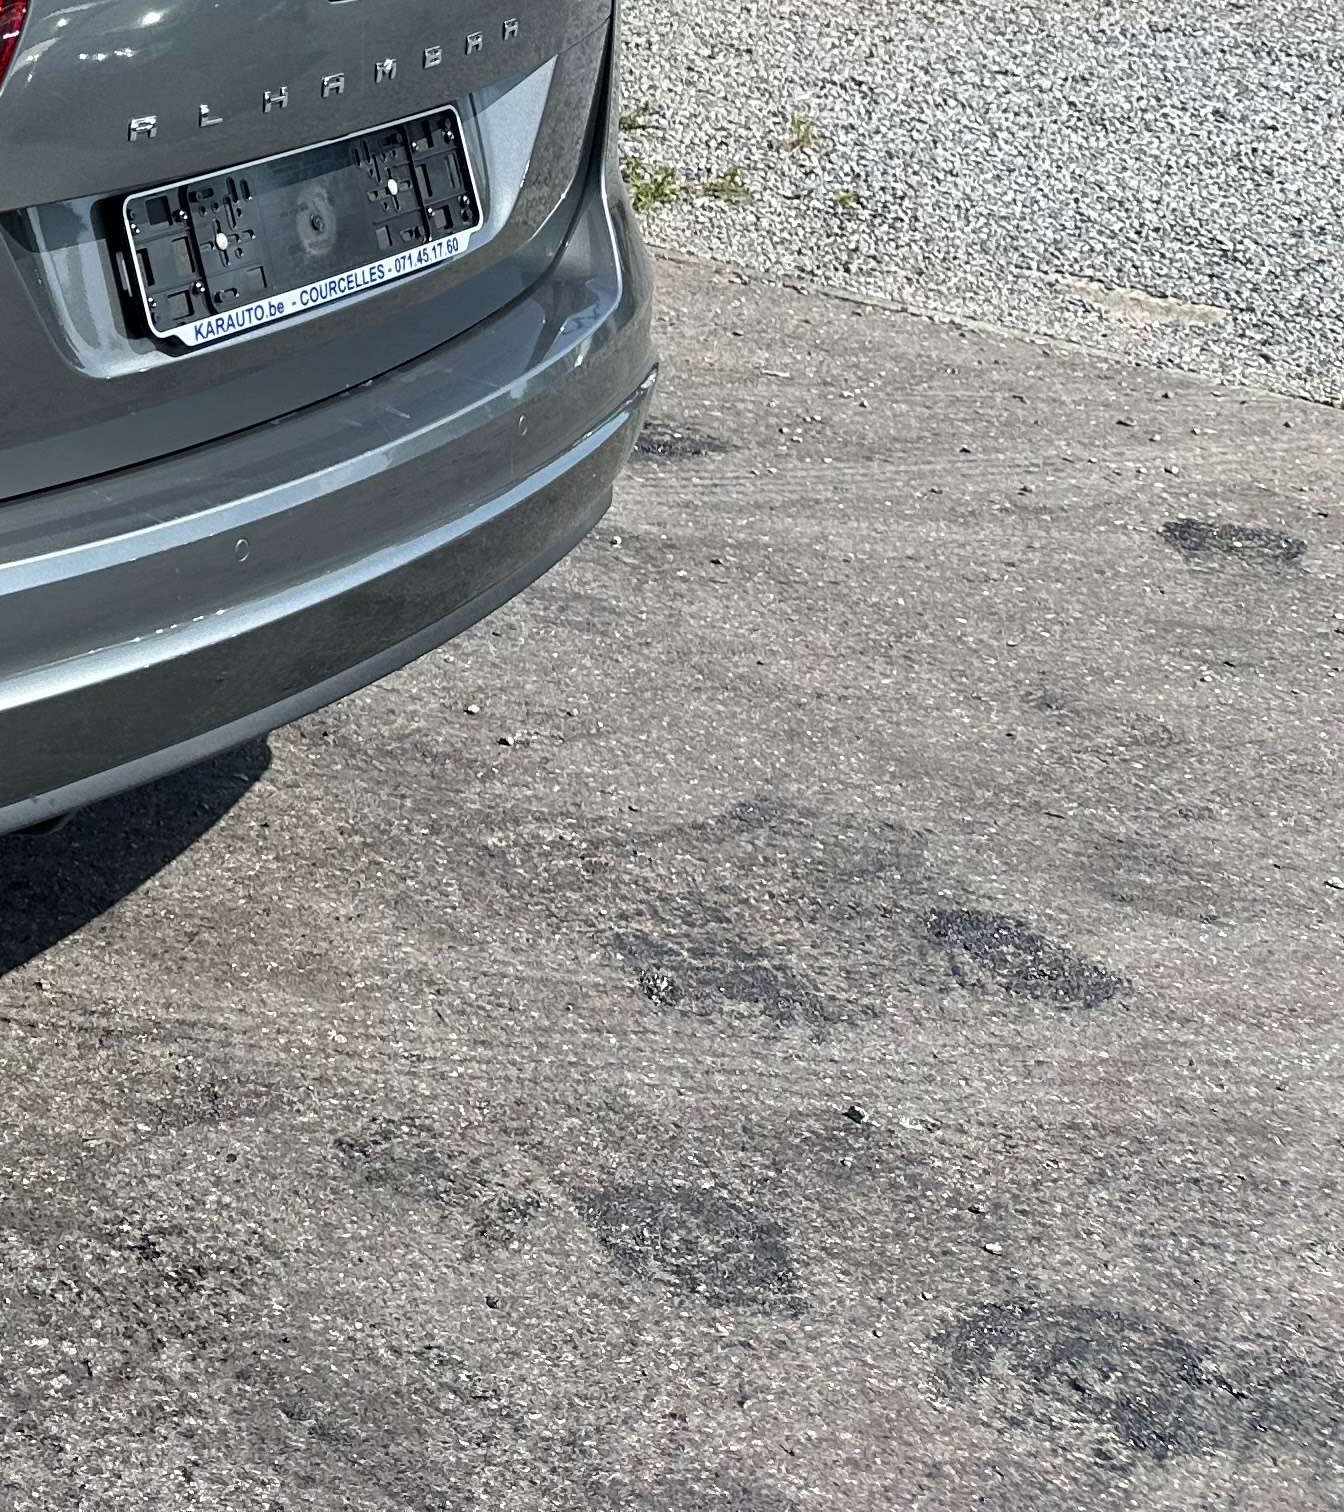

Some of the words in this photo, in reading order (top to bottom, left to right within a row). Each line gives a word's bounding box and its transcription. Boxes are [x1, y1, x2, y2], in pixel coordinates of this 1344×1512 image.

[128, 17, 519, 142] ALHAMBRA
[194, 301, 285, 341] KARAUTO.be
[299, 264, 385, 306] COURCELLES
[394, 237, 459, 273] 071.45.17.60
